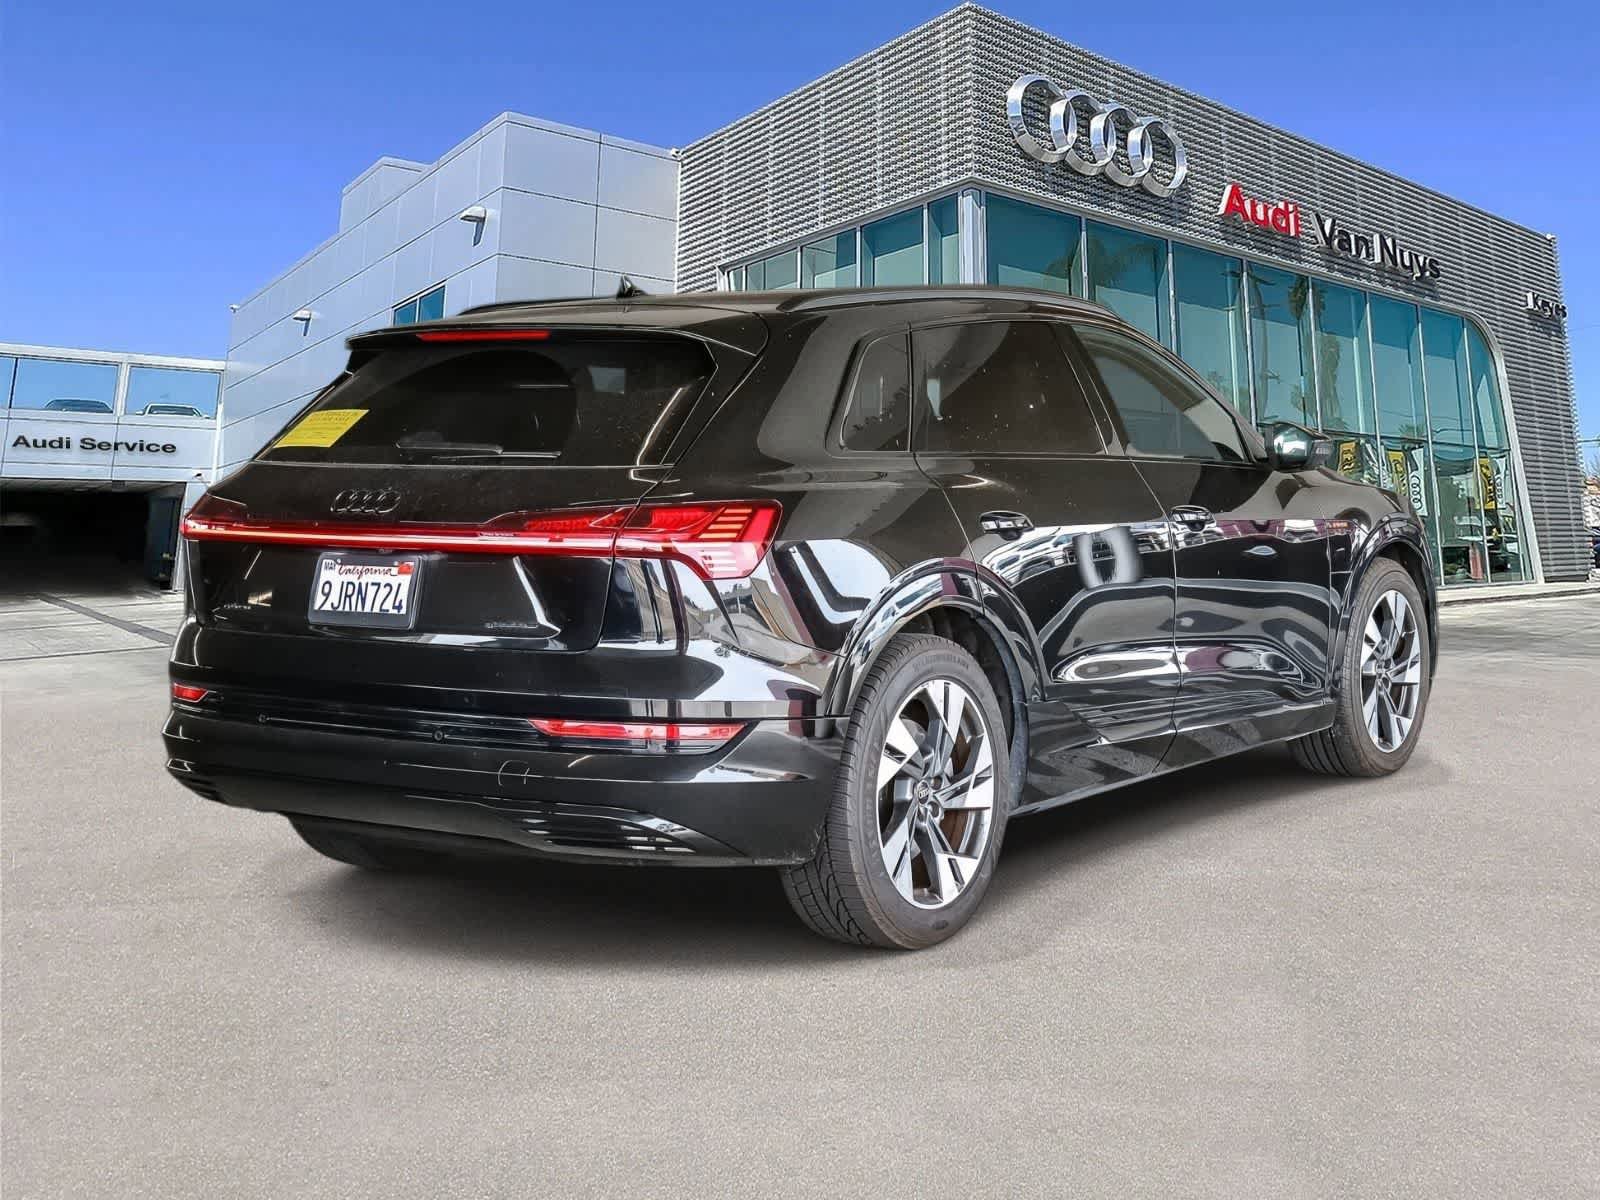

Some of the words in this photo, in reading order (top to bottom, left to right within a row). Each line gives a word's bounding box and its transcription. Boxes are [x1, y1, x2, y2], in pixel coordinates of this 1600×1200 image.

[1215, 182, 1301, 238] Audi
[1310, 211, 1372, 260] Van
[1373, 233, 1441, 280] Nuys
[1526, 291, 1567, 319] Keyes
[12, 435, 71, 450] Audi
[79, 437, 177, 454] Service
[338, 564, 398, 581] California
[318, 580, 404, 614] 9JRN724
